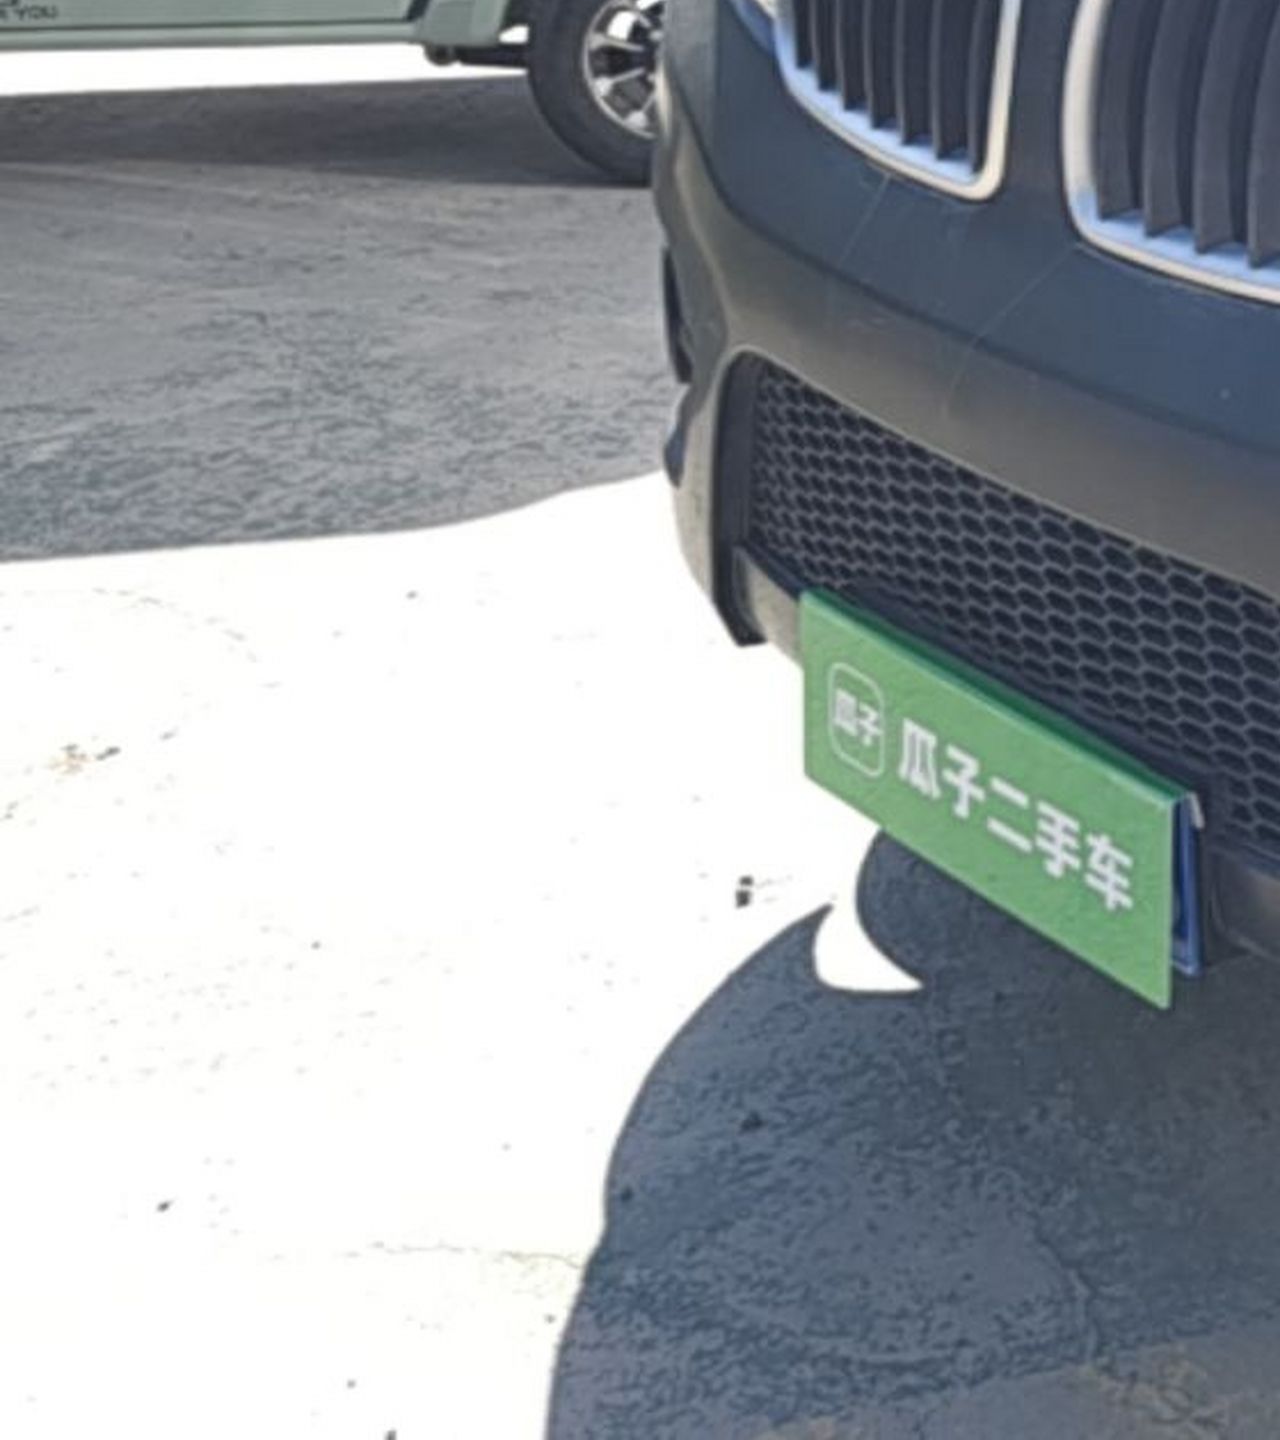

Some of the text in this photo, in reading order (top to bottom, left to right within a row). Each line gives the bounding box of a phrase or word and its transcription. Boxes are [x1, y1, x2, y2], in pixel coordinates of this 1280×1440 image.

[899, 717, 1133, 912] 瓜子二手车
